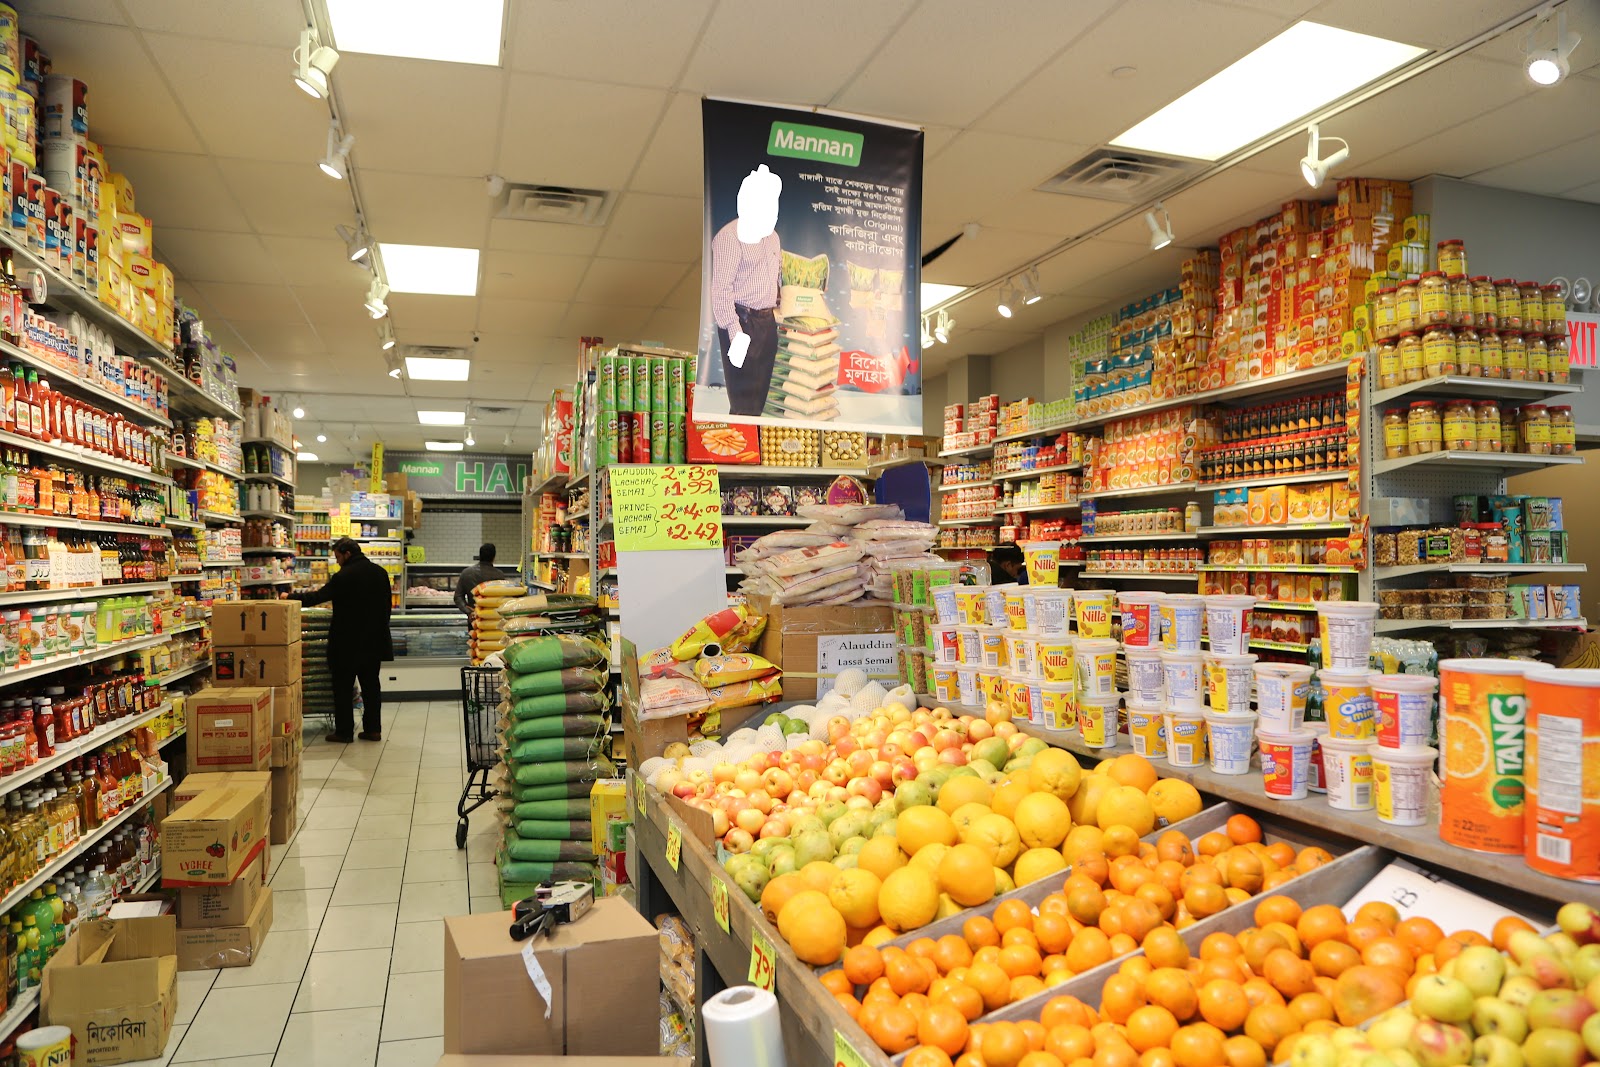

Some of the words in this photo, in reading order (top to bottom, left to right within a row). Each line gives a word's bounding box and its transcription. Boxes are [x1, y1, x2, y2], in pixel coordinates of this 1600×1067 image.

[774, 128, 854, 158] Mannan
[121, 224, 140, 233] ipton
[863, 219, 904, 232] (Original)
[1567, 320, 1598, 366] XIT
[401, 463, 439, 474] Mannan
[660, 466, 677, 480] 2
[616, 488, 645, 497] SEMAI
[619, 503, 650, 512] PRINCE
[660, 503, 678, 521] 2
[618, 525, 647, 535] SEMAI
[666, 522, 719, 540] $2.49
[1034, 560, 1056, 570] Nilla
[1082, 611, 1106, 622] Nilla
[838, 640, 893, 650] Alauddin
[838, 658, 863, 666] Lassa
[865, 656, 893, 665] Semai
[1044, 655, 1068, 666] Nilla
[1097, 664, 1113, 672] Nilla
[1174, 724, 1198, 732] OREO
[1490, 695, 1526, 774] TANG
[180, 860, 213, 871] LYCHEE
[86, 1018, 147, 1043] নিকোবিনা
